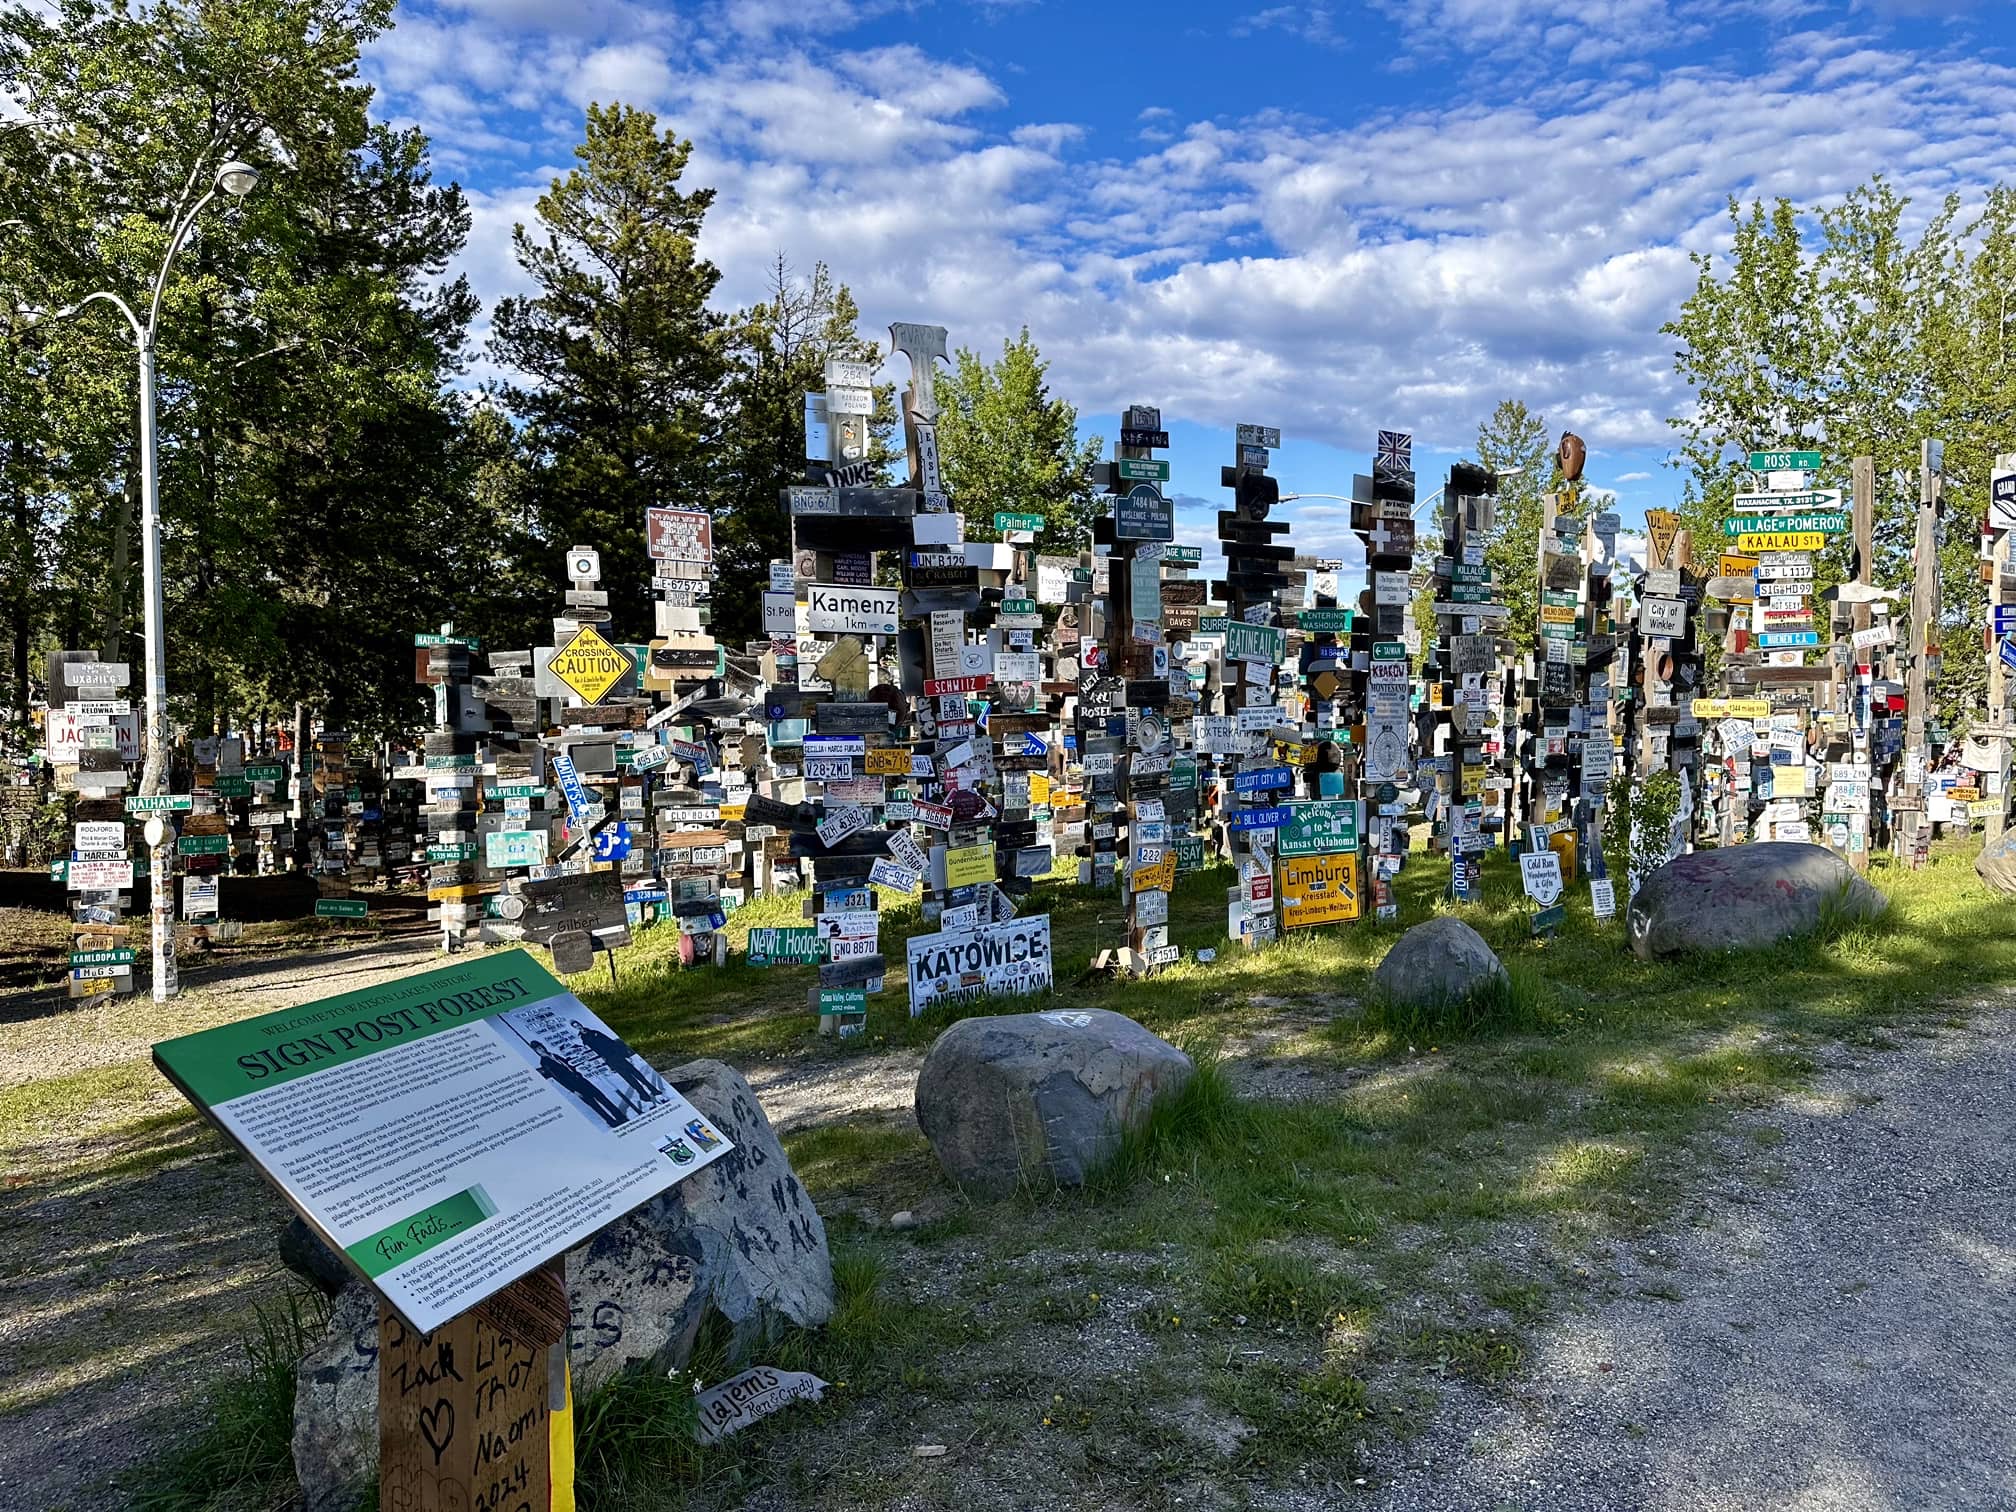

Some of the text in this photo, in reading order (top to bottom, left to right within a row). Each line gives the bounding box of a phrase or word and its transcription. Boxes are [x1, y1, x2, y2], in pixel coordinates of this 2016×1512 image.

[843, 369, 862, 380] 254
[1764, 454, 1791, 468] ROSS
[1132, 496, 1159, 509] 7484 km
[1000, 515, 1032, 530] Palmer
[1150, 511, 1169, 522] POLSKA
[1728, 518, 1779, 533] VILLAGE
[1788, 518, 1842, 531] POMEROY
[1747, 535, 1814, 548] KA'ALAU ST
[1181, 548, 1201, 559] WHITE
[1458, 566, 1487, 575] KILLALOE
[1759, 568, 1771, 577] LB
[813, 591, 896, 615] Kamenz
[1003, 602, 1021, 612] IOLA
[1785, 602, 1800, 610] SEXY
[1651, 605, 1678, 618] City of
[851, 618, 867, 630] km
[933, 618, 955, 626] Research
[1169, 618, 1192, 626] DAVES
[1303, 621, 1349, 630] WASHOUGAL
[1650, 619, 1675, 631] Winkler
[565, 649, 612, 657] CROSSING
[800, 640, 835, 654] OBEY
[1383, 646, 1401, 655] TAIWAN
[555, 657, 622, 674] CAUTION
[1371, 683, 1407, 693] MONTESANO
[956, 724, 970, 736] 413
[1334, 731, 1343, 741] BC
[892, 756, 910, 769] 719
[251, 768, 277, 776] ELBA
[1236, 777, 1258, 789] ELLICOTT
[1278, 773, 1287, 783] MD
[128, 797, 173, 810] NATHAN
[1243, 812, 1279, 826] BILL OLIVER
[1298, 808, 1337, 824] Welcome
[1314, 822, 1322, 832] to
[427, 843, 460, 853] ABILENE
[1282, 837, 1355, 850] Kansas Oklahoma
[71, 862, 104, 872] ALASKA
[1527, 859, 1540, 869] Cold
[1287, 865, 1350, 887] Limburg
[1527, 871, 1558, 880] Woodworking
[1541, 880, 1554, 888] Gifts
[845, 895, 866, 907] 3321
[1301, 890, 1338, 901] Kreisstadt
[1289, 903, 1353, 917] Kreis-Limburg-Weilburg
[557, 917, 600, 933] Gilbert
[750, 929, 781, 955] Newt
[853, 940, 874, 954] 8870
[73, 953, 117, 964] KAMLOOPA
[917, 930, 1043, 982] KATOWICE
[1029, 972, 1046, 986] KM
[260, 972, 472, 1036] WELCOME TO WATSON LAKE'S HISTORIC
[237, 977, 529, 1079] SIGN POST FOREST
[375, 1235, 408, 1260] Fun
[409, 1266, 418, 1275] of
[432, 1250, 450, 1262] there
[449, 1243, 464, 1253] were
[463, 1235, 478, 1246] close
[483, 1219, 508, 1235] 100,000
[745, 1399, 772, 1418] Ken
[779, 1377, 815, 1402] Cindy
[474, 1386, 545, 1476] Naomi
